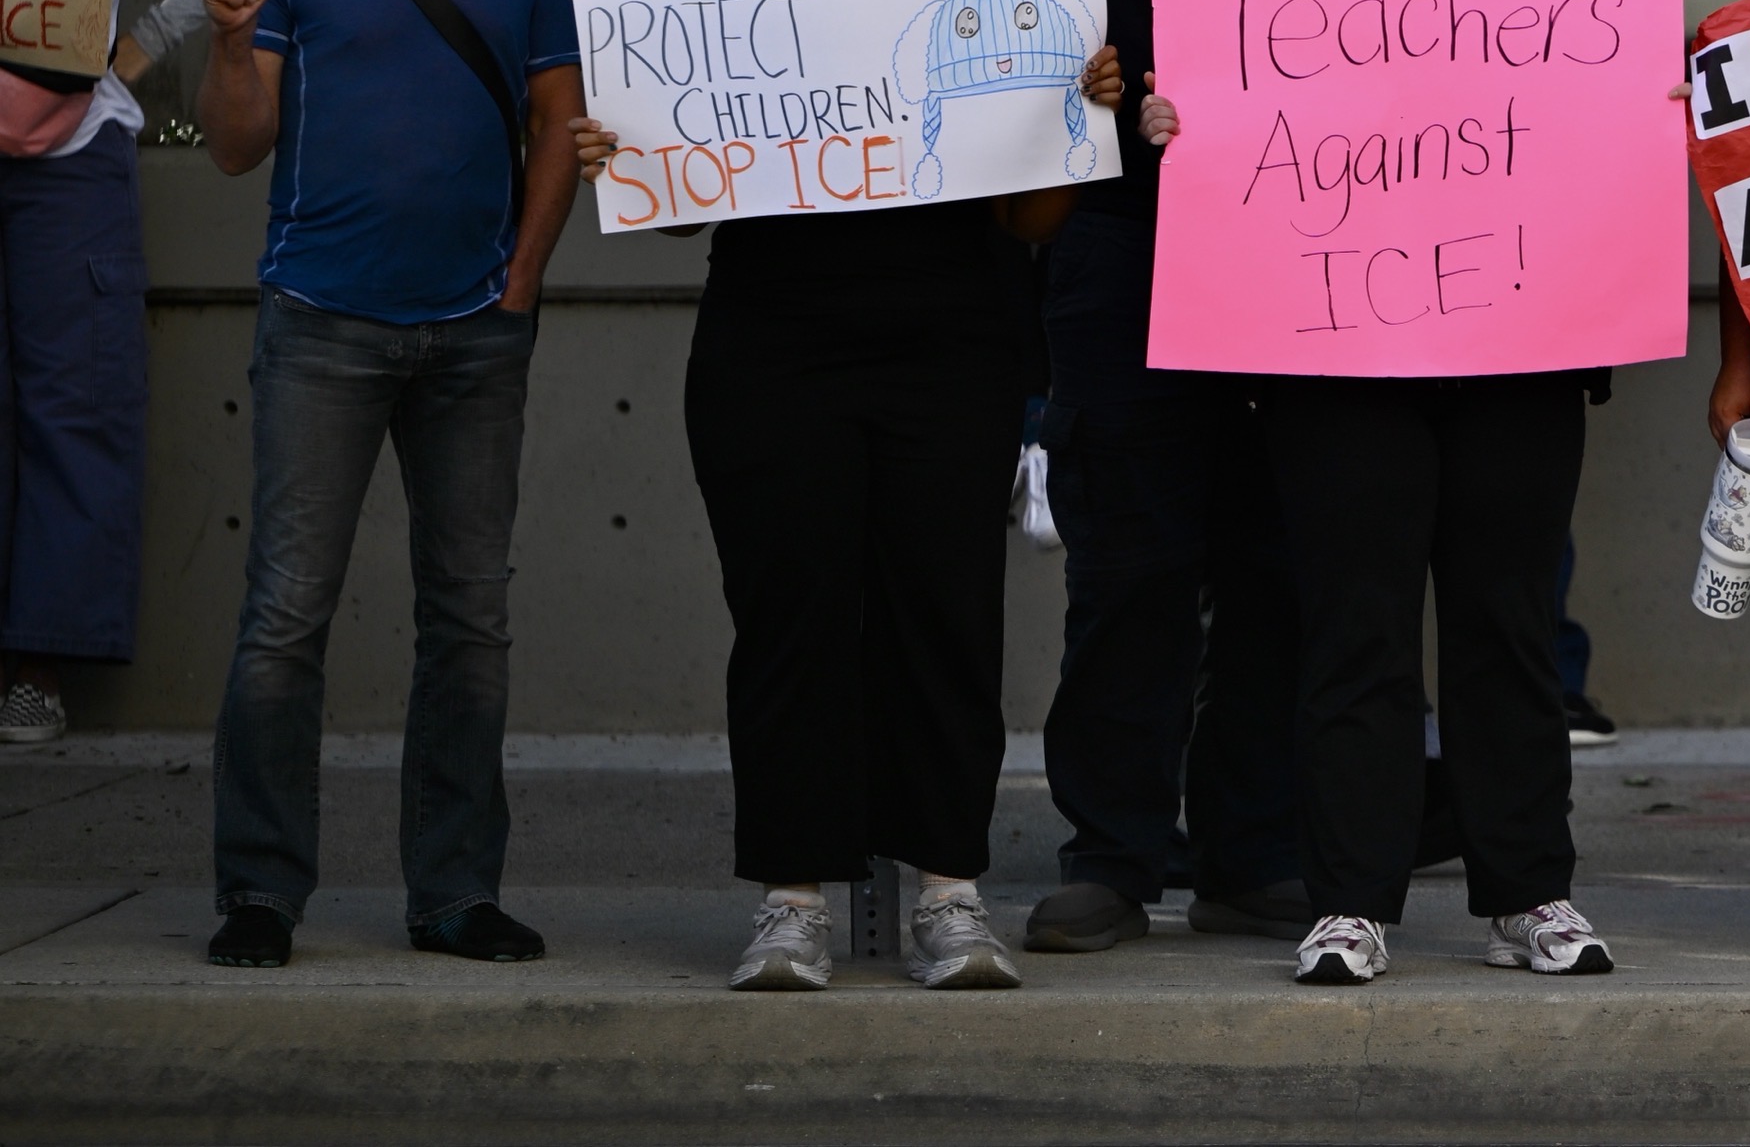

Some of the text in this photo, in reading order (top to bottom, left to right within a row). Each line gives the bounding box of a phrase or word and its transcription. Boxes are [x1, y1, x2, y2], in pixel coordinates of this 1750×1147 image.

[673, 77, 909, 146] CHILDREN.
[607, 136, 908, 226] STOP ICE!
[1243, 96, 1531, 238] Against
[1296, 224, 1524, 333] ICE!
